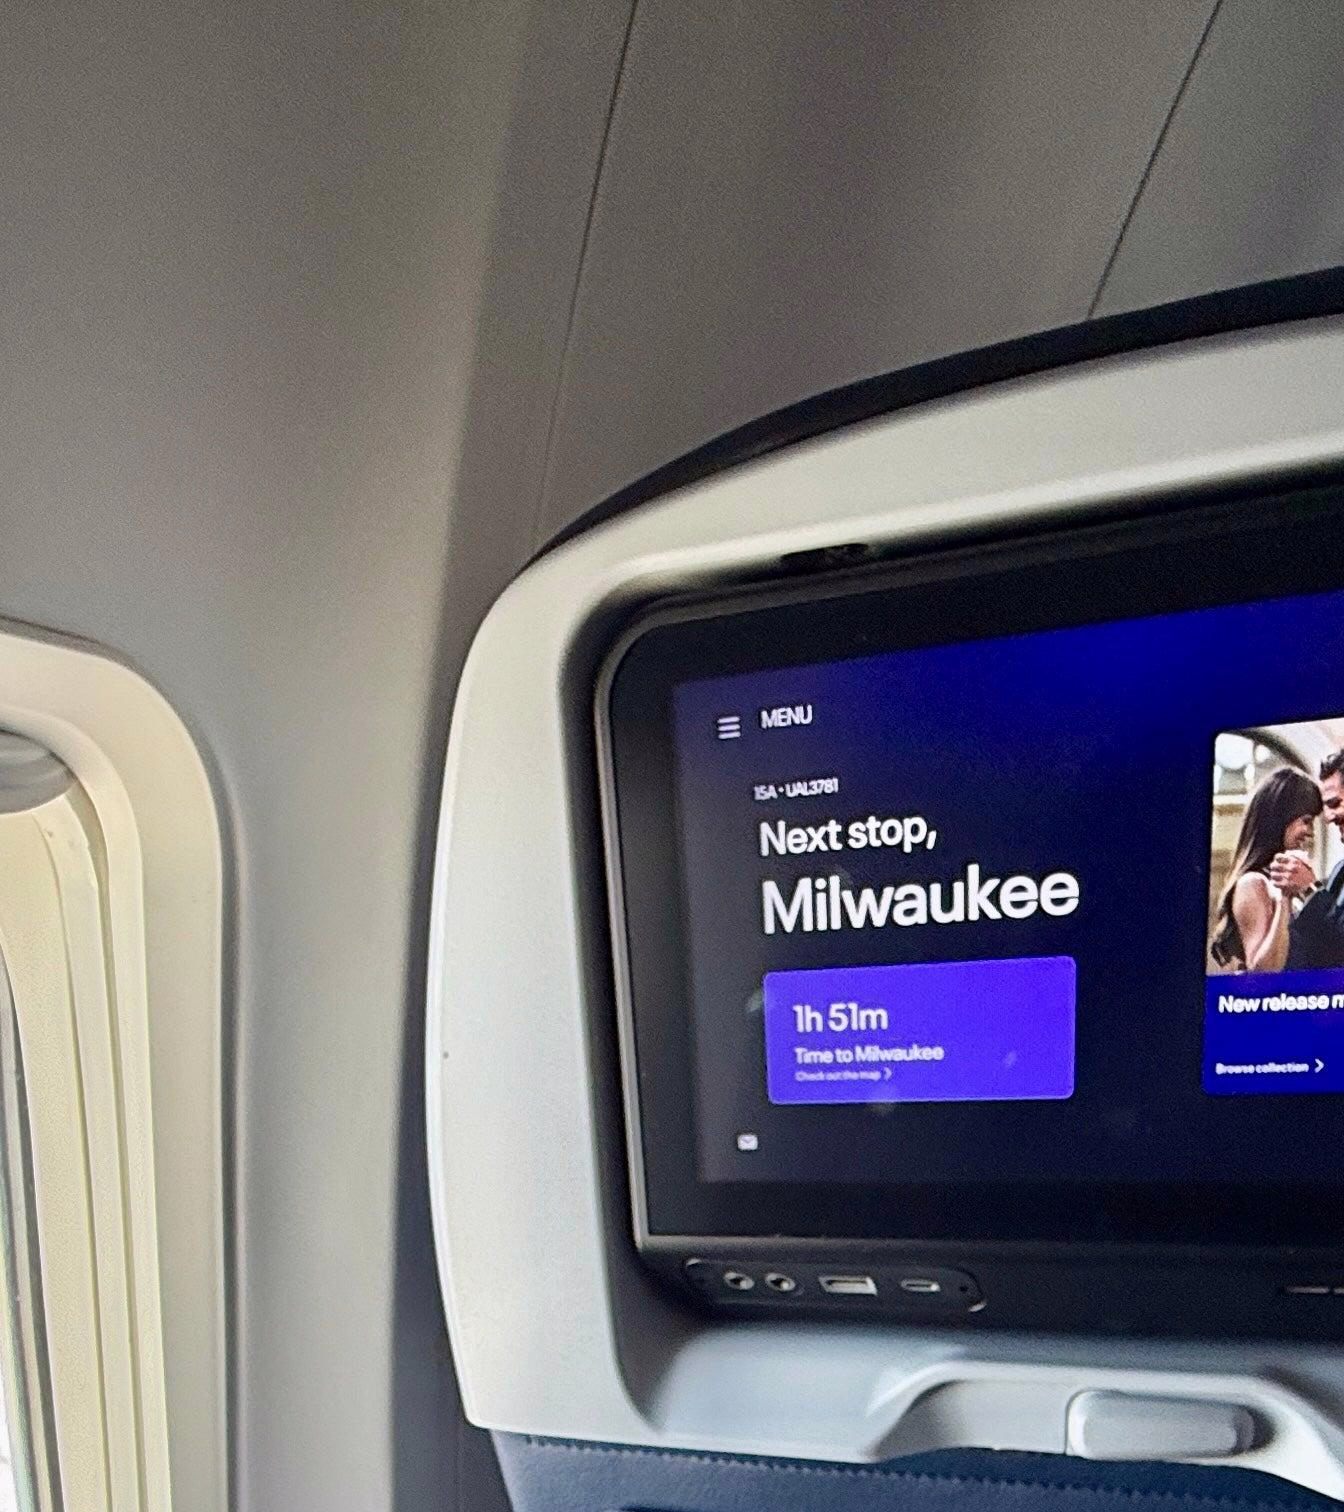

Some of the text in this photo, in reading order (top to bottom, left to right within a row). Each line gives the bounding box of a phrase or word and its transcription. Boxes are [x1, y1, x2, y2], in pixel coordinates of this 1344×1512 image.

[761, 704, 813, 729] MENU
[785, 777, 839, 798] UAL3781
[759, 814, 938, 857] Next stop,
[763, 863, 1080, 935] Milwaukee
[1219, 995, 1260, 1013] New
[1262, 993, 1330, 1011] release
[793, 1002, 888, 1032] 1h 51m
[795, 1044, 944, 1063] Time to Milwaukee
